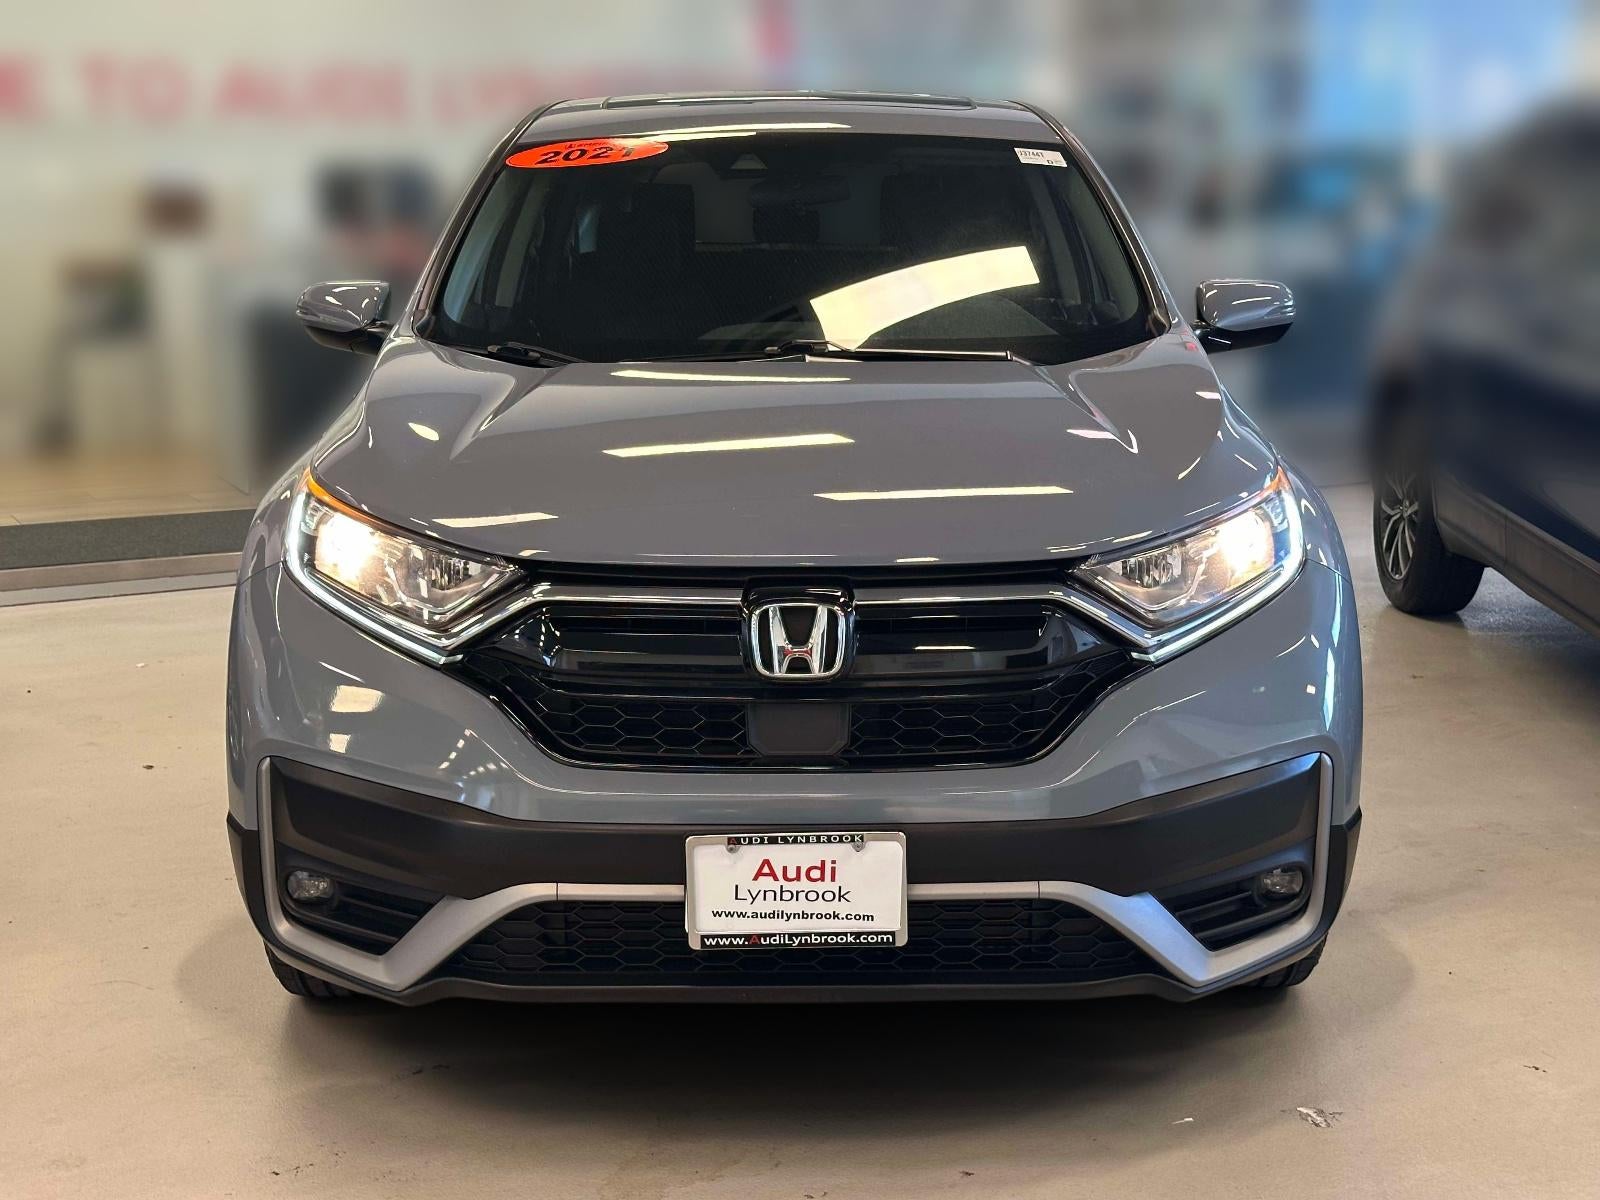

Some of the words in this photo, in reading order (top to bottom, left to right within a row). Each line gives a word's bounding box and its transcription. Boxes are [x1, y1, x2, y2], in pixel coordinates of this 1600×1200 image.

[728, 835, 769, 846] AUDI
[777, 833, 864, 845] LYNBROOK
[751, 858, 837, 883] Audi
[734, 884, 851, 905] Lynbrook
[711, 909, 875, 922] www.audilynbrook.com
[703, 933, 893, 947] www.AudiLynbrook.com
